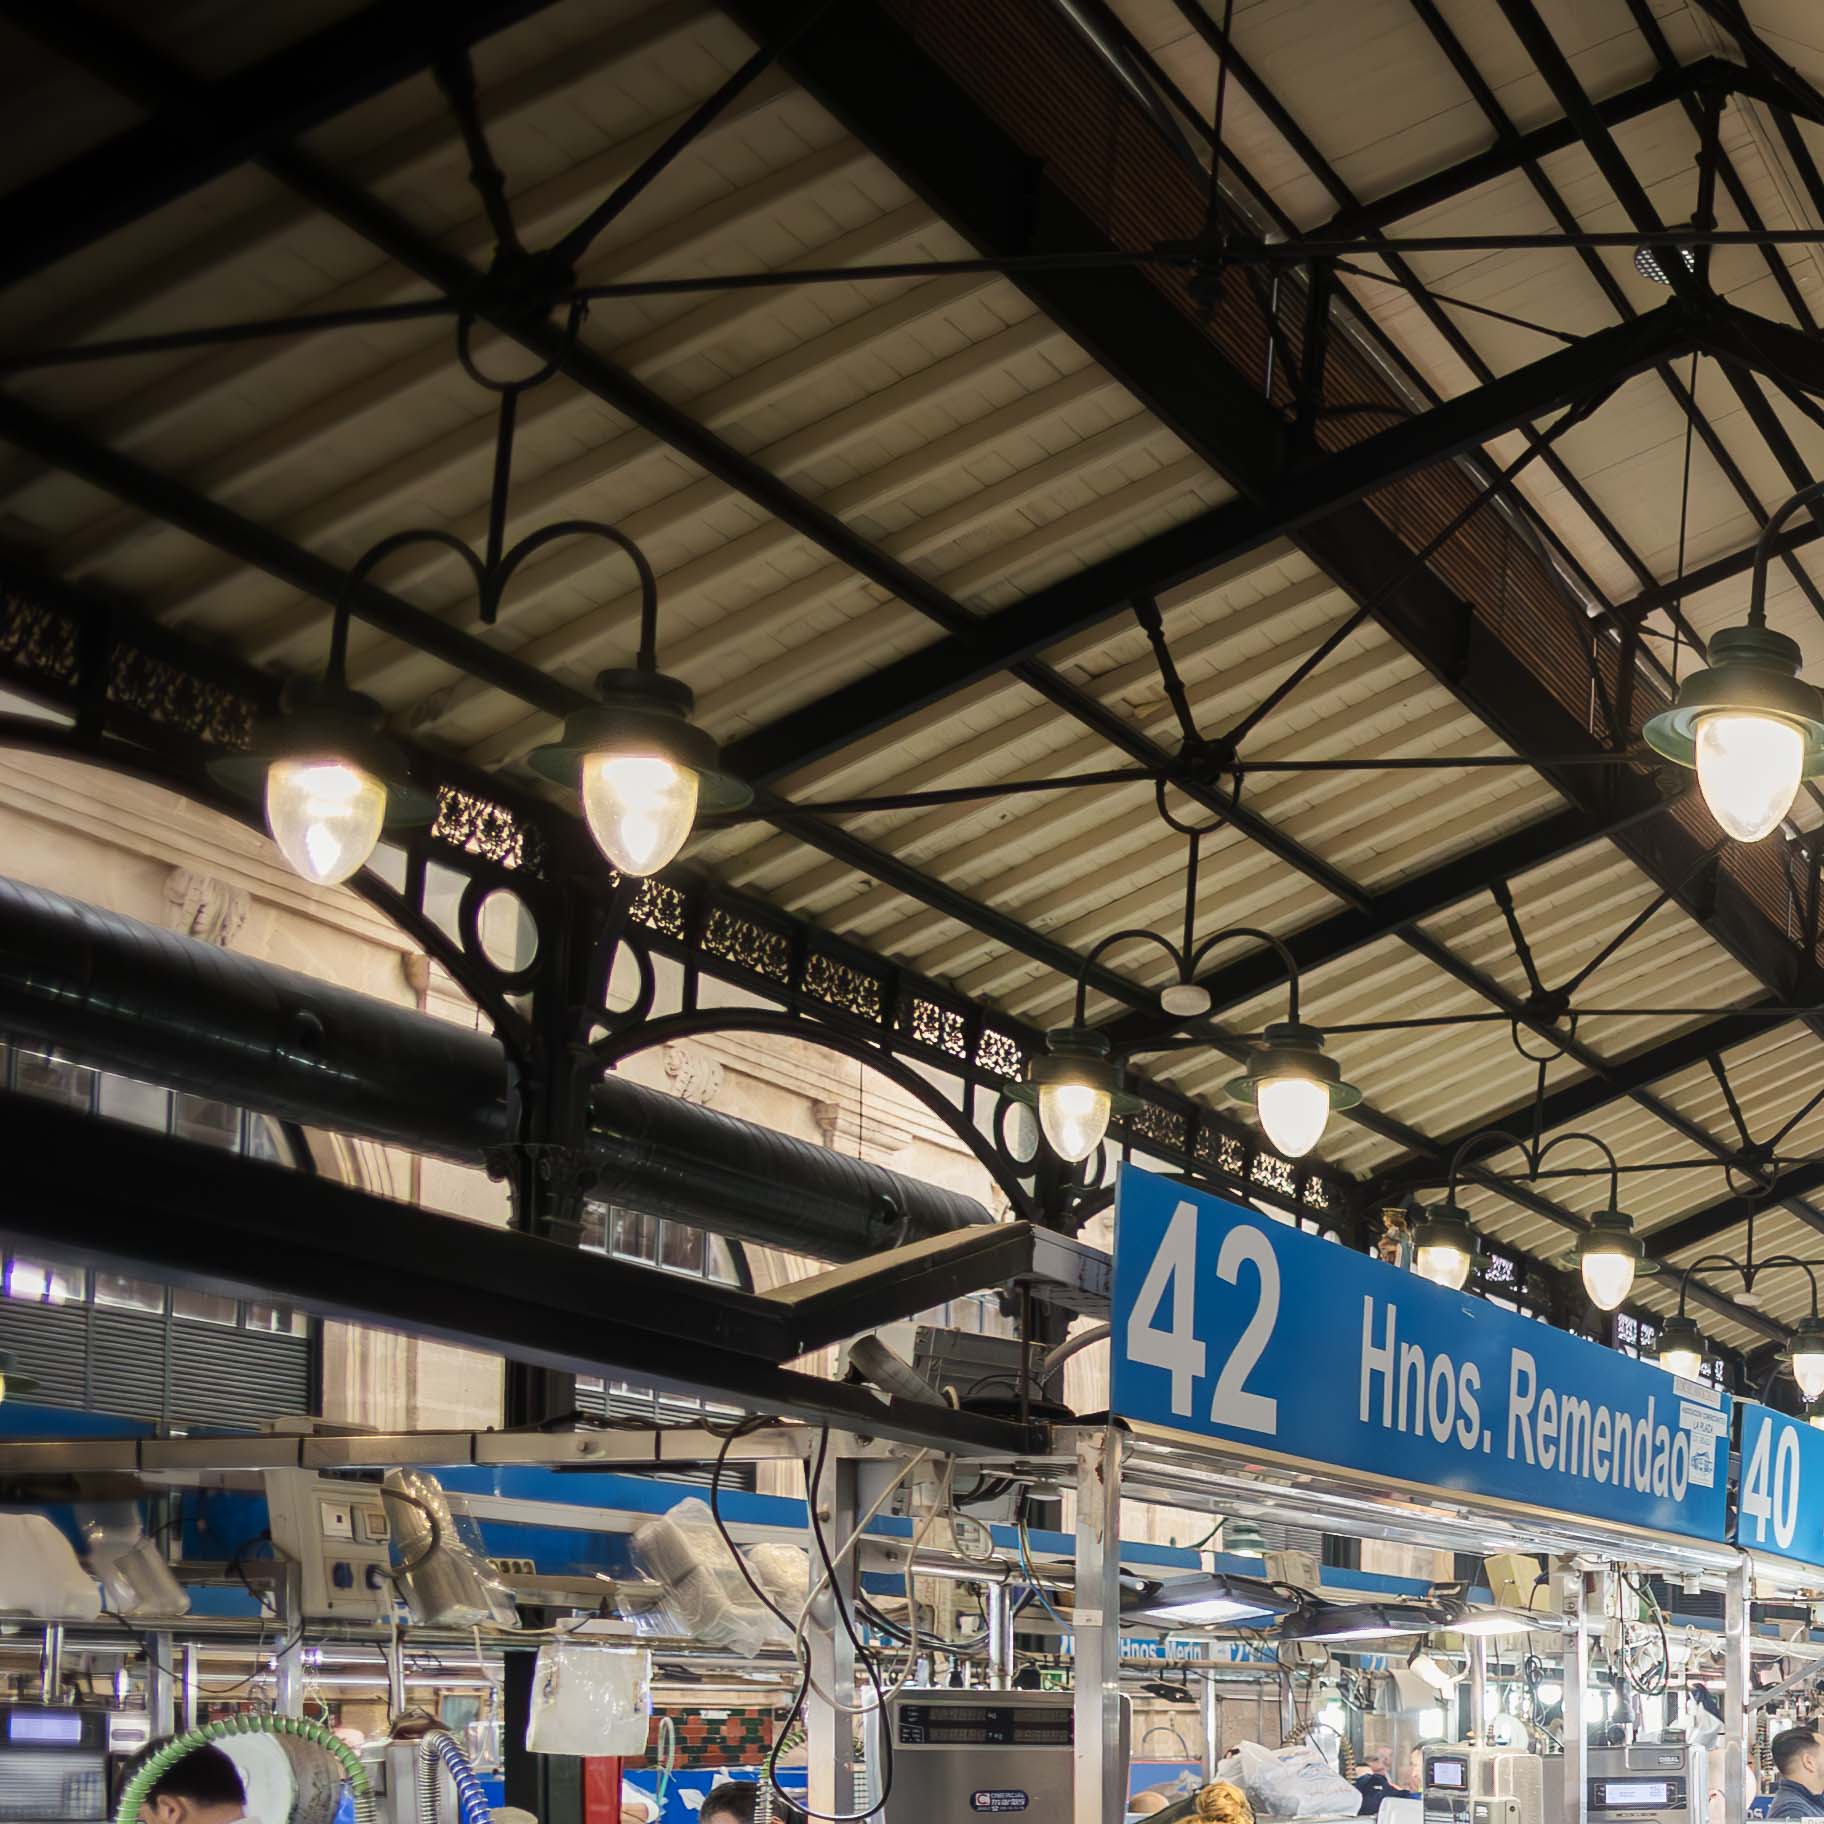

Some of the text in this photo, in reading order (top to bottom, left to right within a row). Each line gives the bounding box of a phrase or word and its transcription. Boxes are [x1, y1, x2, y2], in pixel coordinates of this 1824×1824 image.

[1126, 1200, 1688, 1502] 42 Hnos. Remendao
[1742, 1416, 1800, 1550] 40
